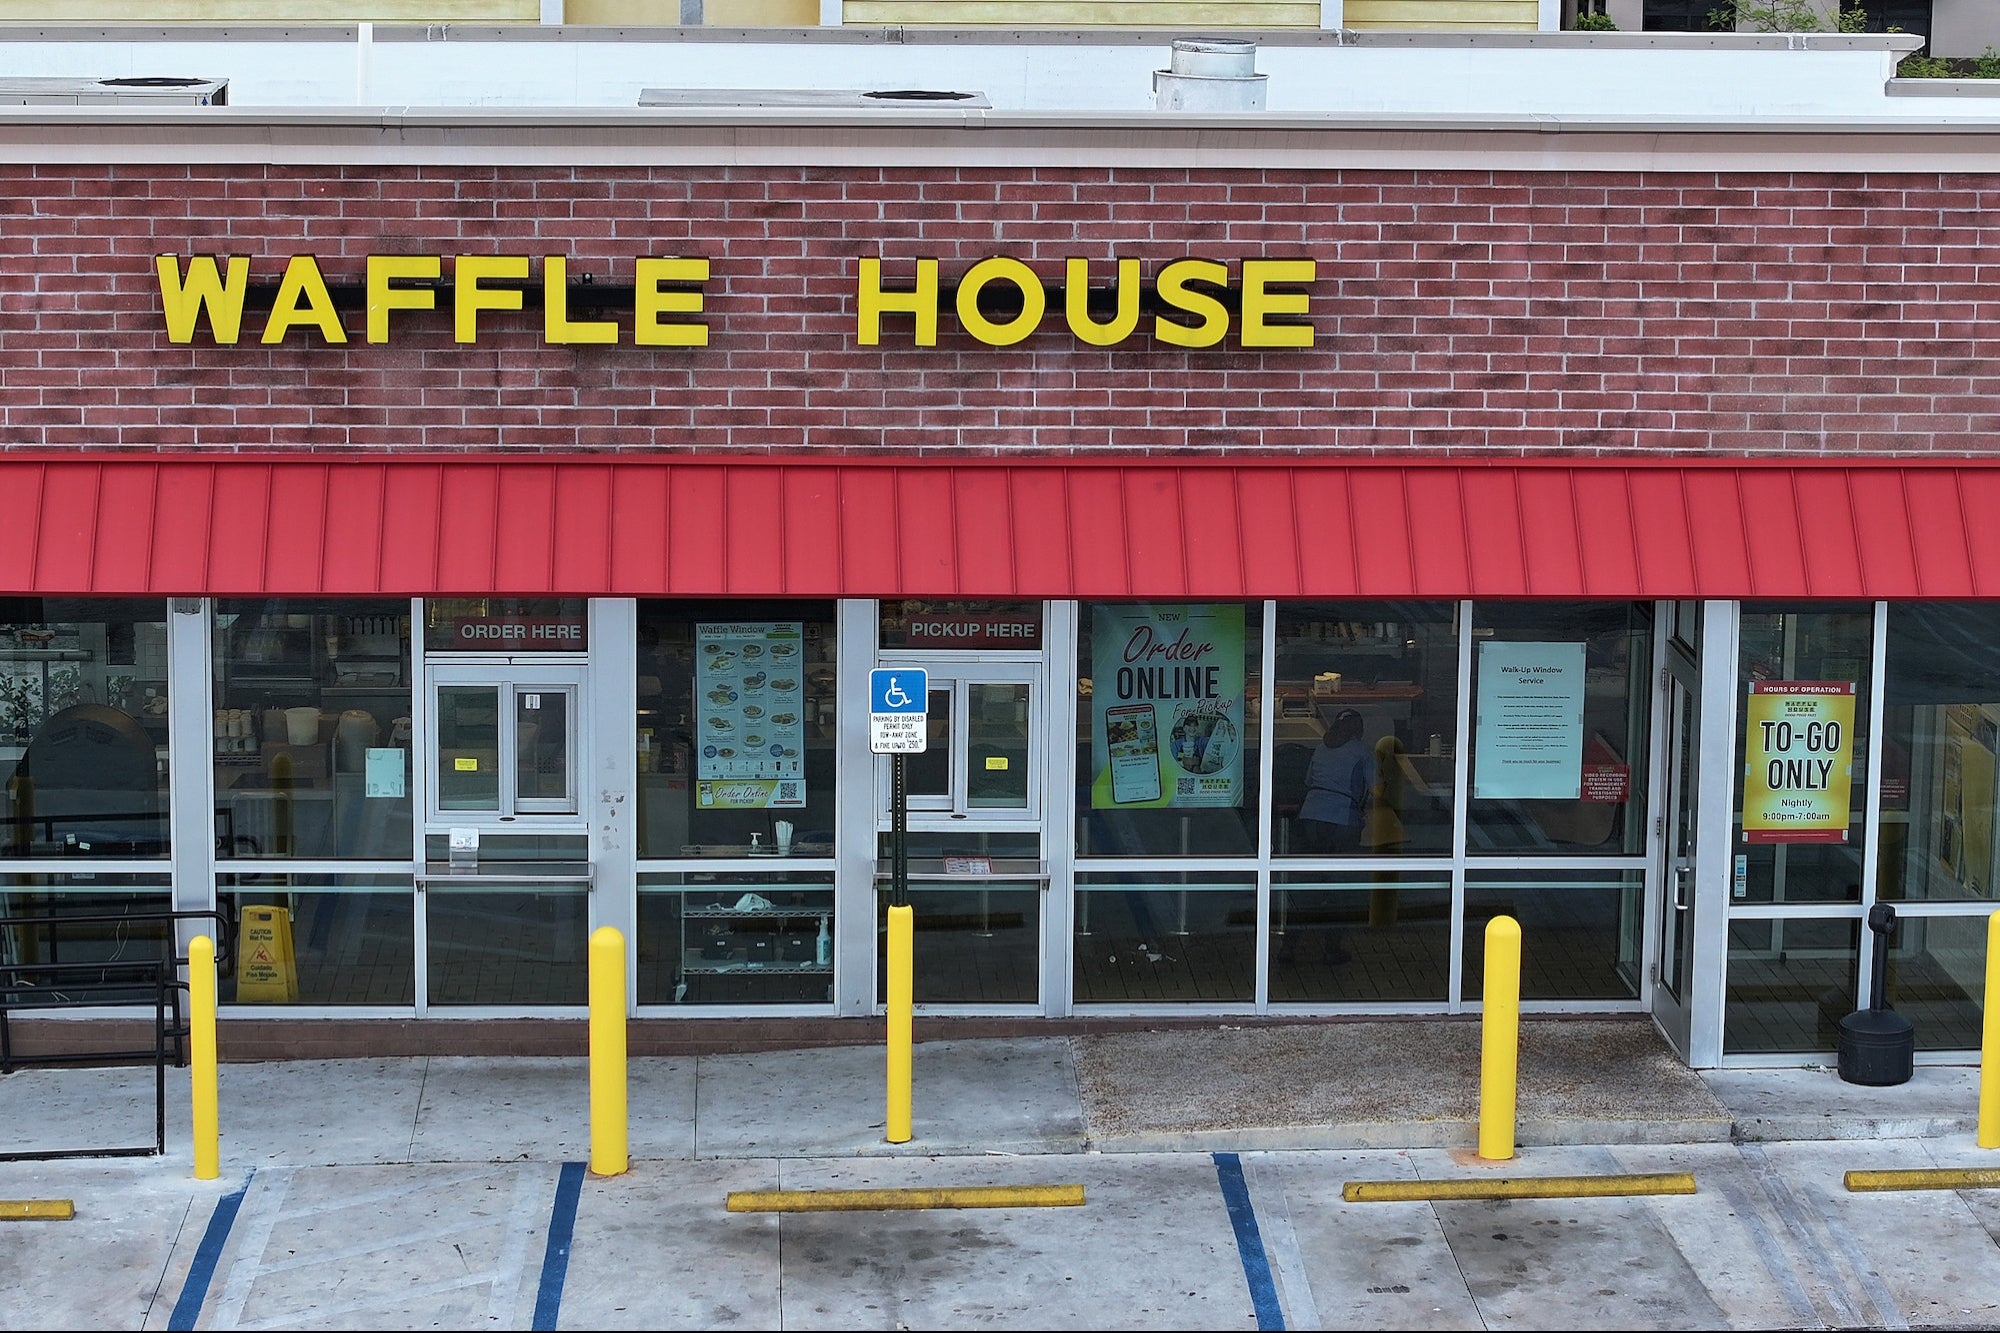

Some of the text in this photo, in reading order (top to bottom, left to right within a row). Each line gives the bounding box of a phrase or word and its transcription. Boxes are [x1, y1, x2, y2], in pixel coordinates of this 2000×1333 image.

[156, 253, 1317, 348] WAFFLE HOUSE
[1158, 613, 1181, 621] NEW
[461, 624, 582, 639] ORDER HERE
[699, 625, 728, 634] Waffle
[729, 625, 765, 634] Window
[911, 623, 1035, 638] PICKUP HERE
[1123, 625, 1214, 663] Order
[1500, 666, 1563, 675] Walk-Up Window
[1117, 666, 1220, 700] ONLINE
[1518, 677, 1544, 685] Service
[1172, 695, 1233, 719] For Pickup
[1760, 721, 1841, 753] TO-GO
[1767, 758, 1835, 790] ONLY
[715, 786, 770, 798] Order Online
[1781, 799, 1813, 808] Nightly
[1762, 812, 1830, 822] 9:00pm-7:00am
